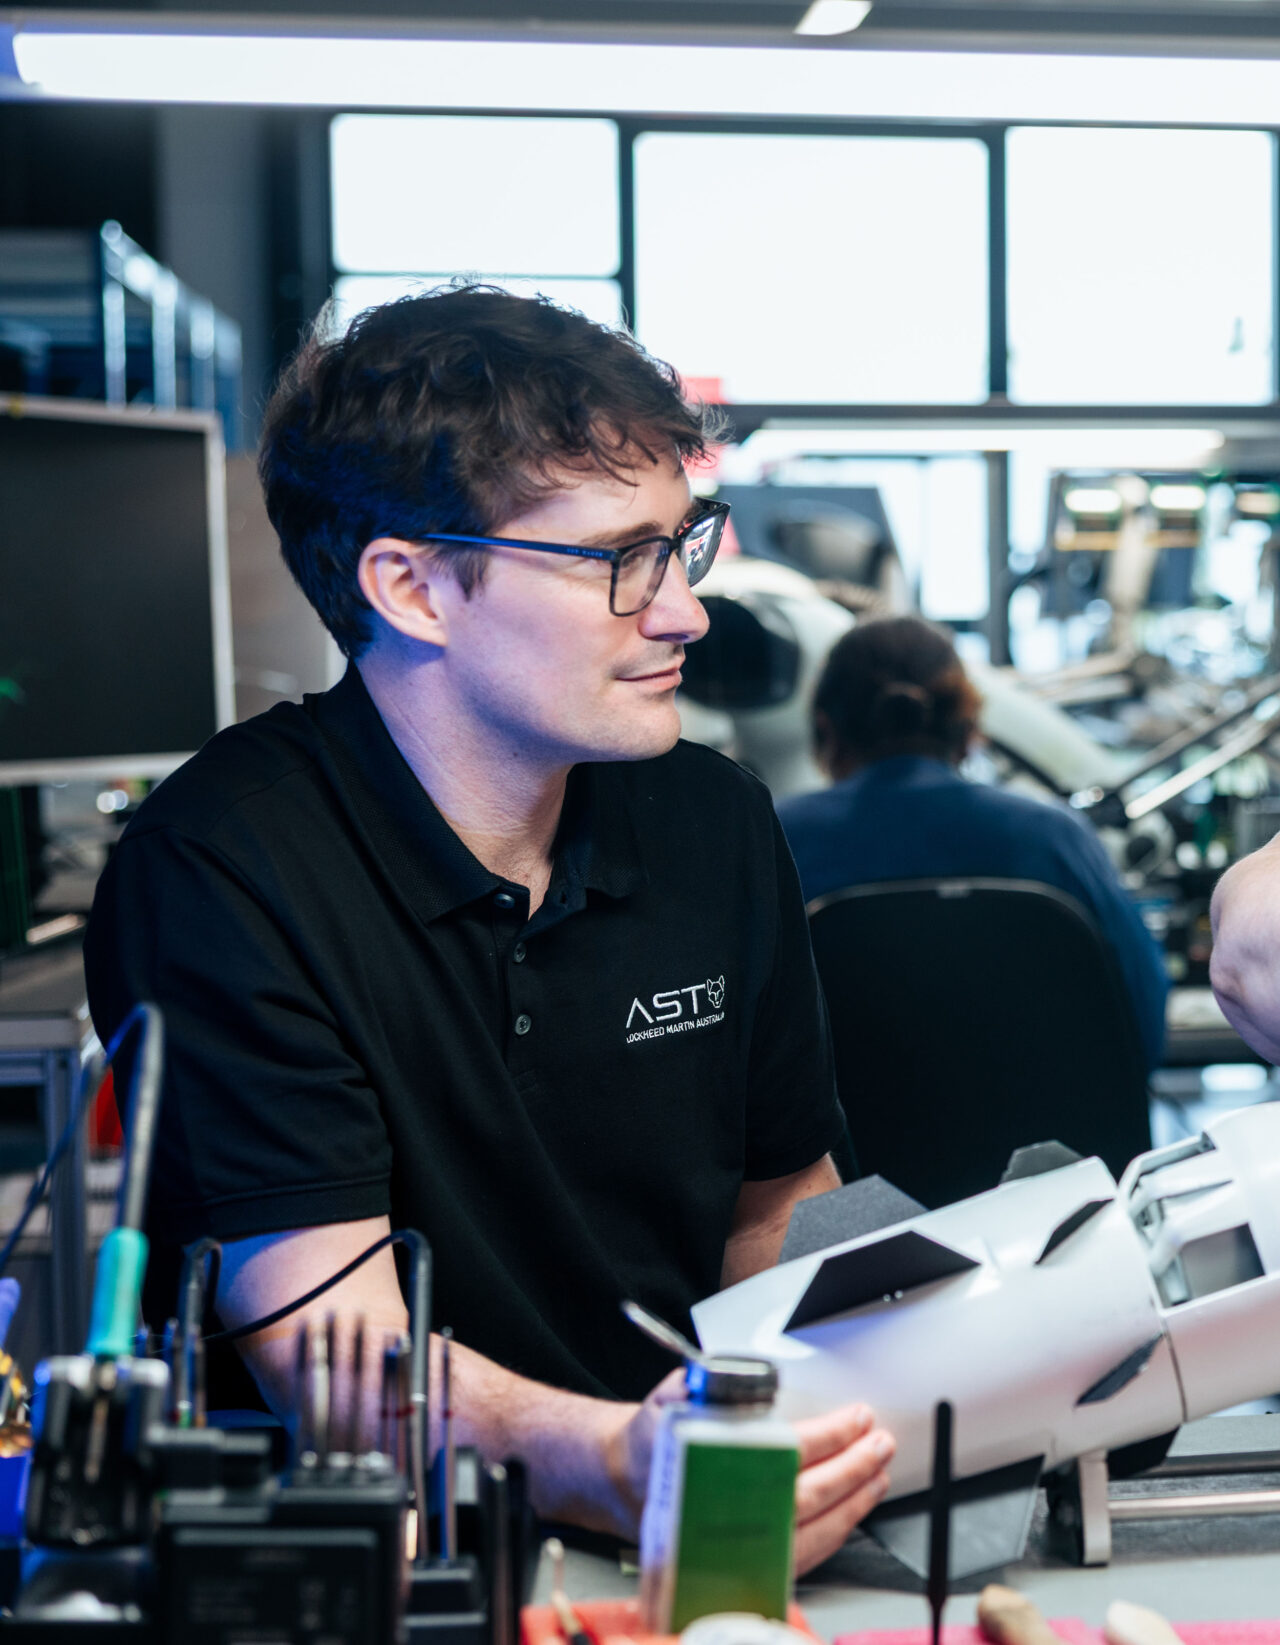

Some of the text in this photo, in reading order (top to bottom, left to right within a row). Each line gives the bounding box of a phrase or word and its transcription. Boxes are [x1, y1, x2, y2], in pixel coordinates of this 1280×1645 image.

[626, 983, 706, 1029] AST
[626, 1026, 665, 1044] LOCKHEED
[666, 1020, 695, 1034] MARTIN
